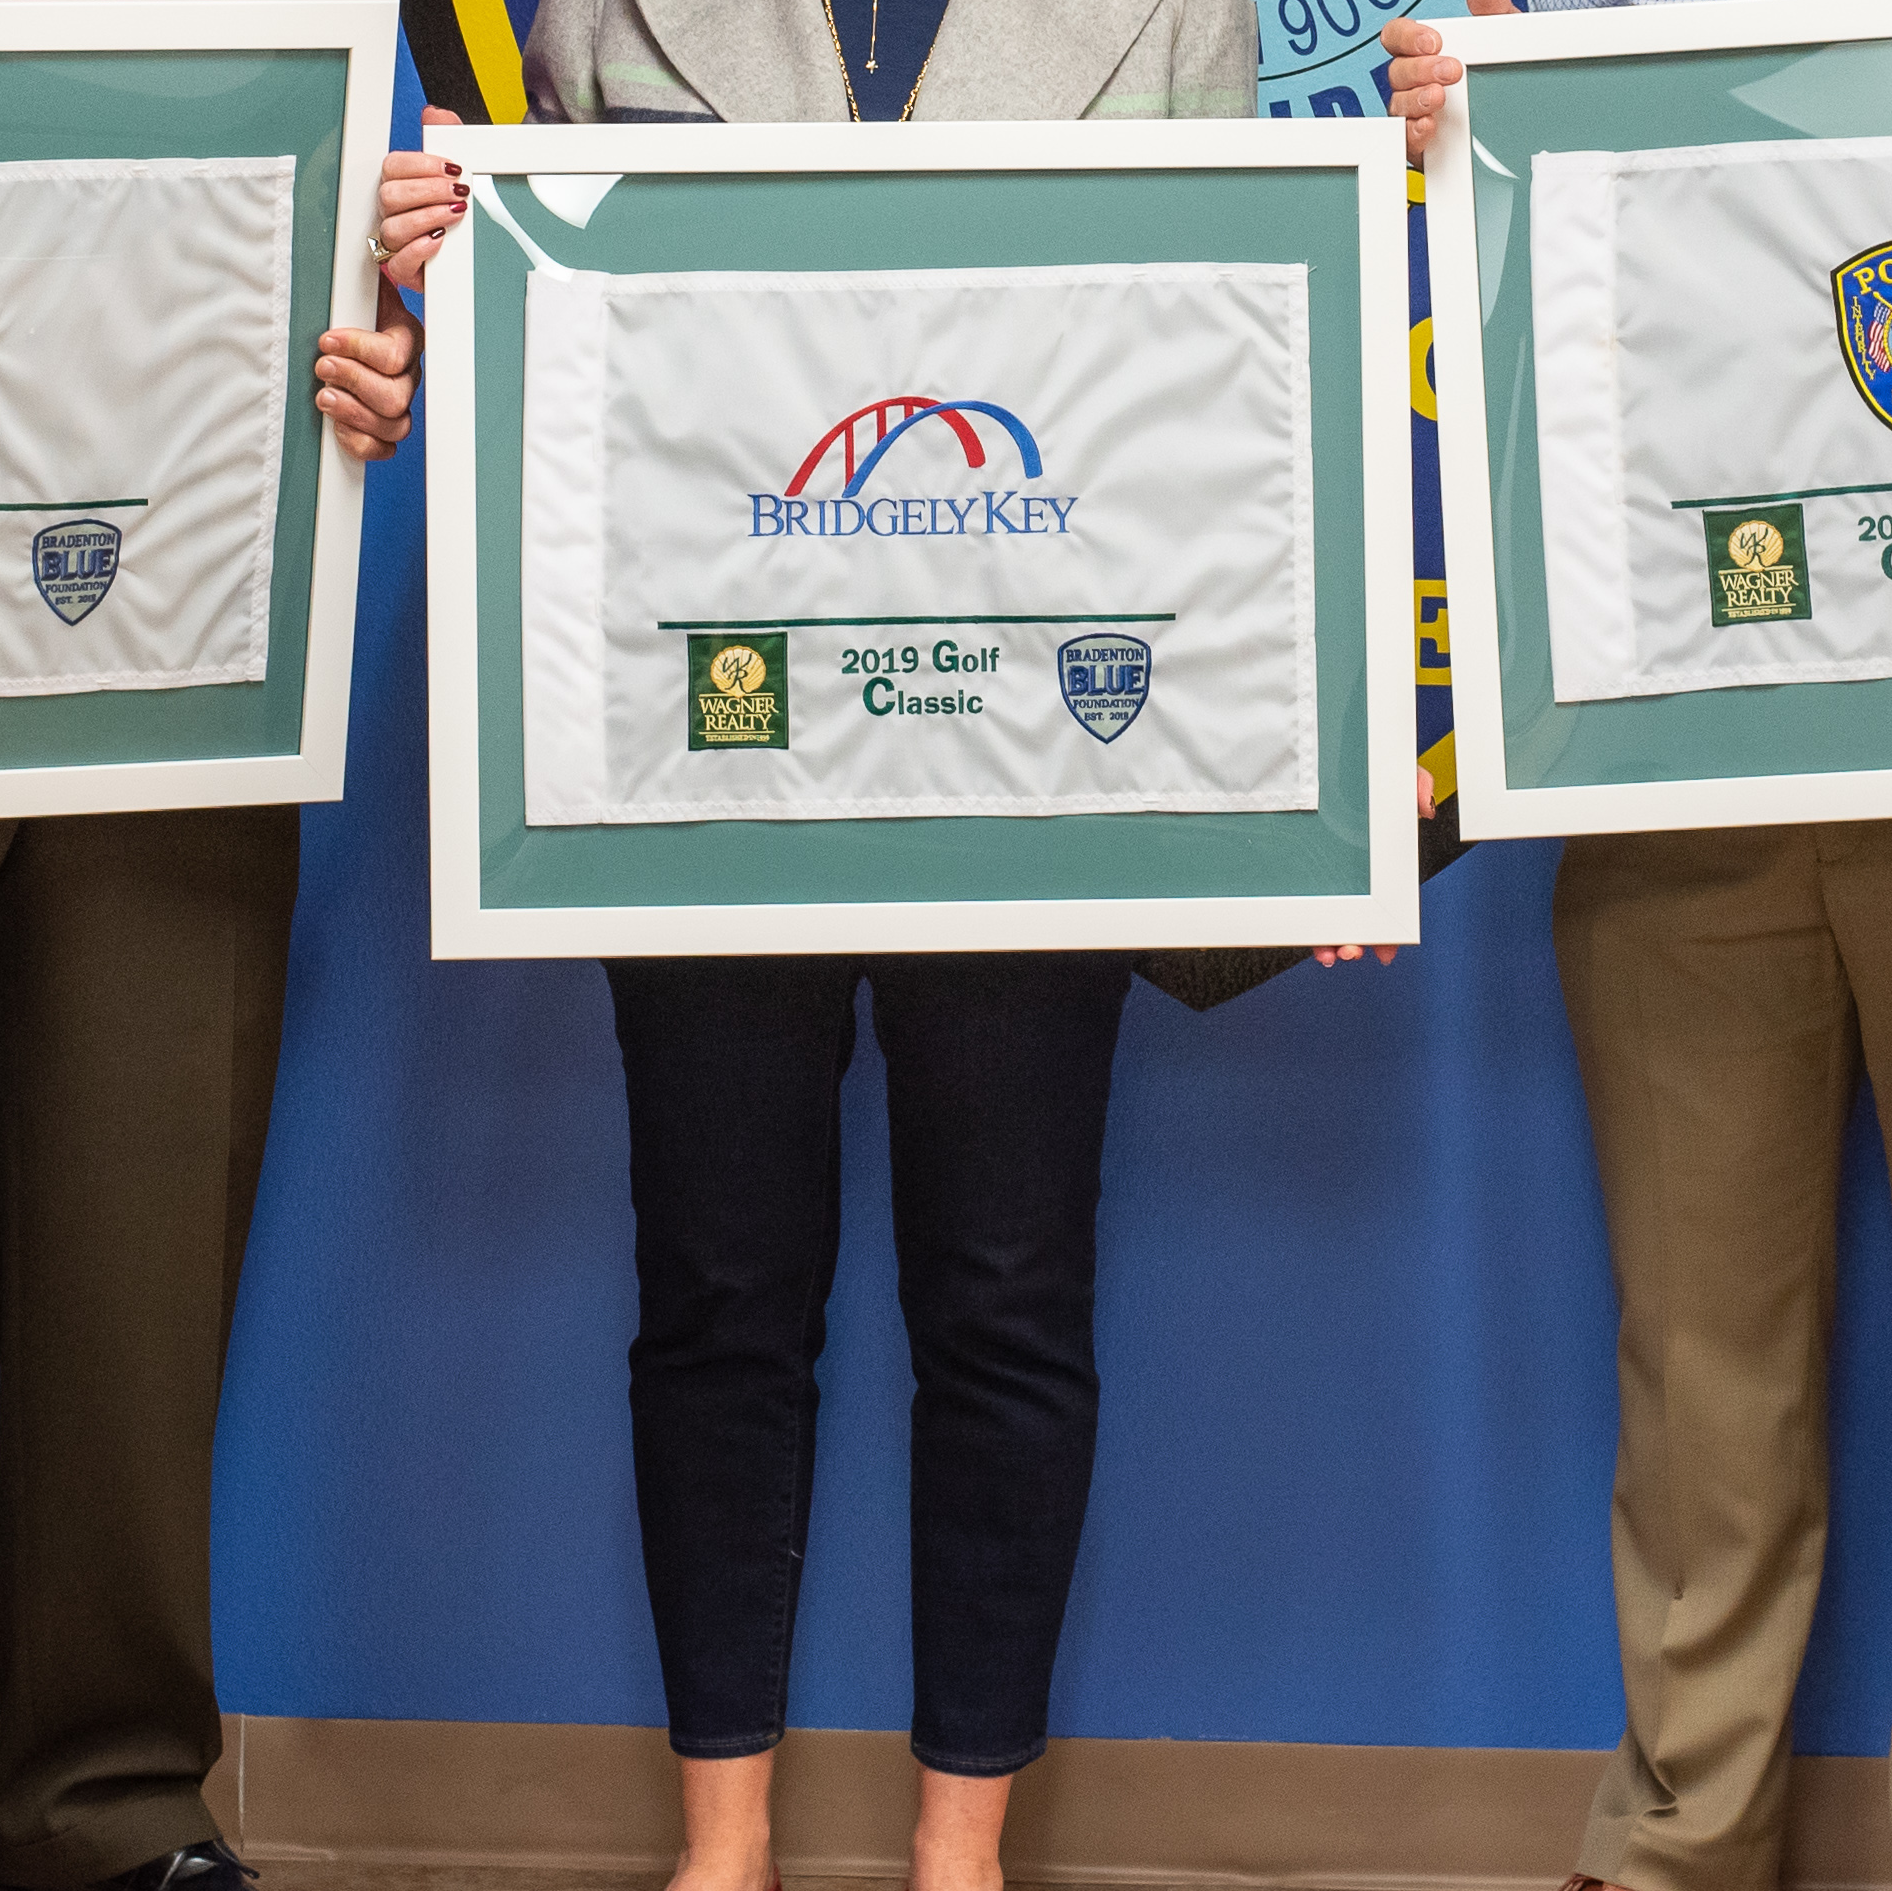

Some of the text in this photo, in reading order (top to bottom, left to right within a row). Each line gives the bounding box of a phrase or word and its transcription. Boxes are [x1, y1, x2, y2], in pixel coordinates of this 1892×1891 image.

[747, 491, 1079, 537] BRIDGELY KEY
[41, 533, 115, 548] BRADENTON
[41, 549, 114, 581] BLUE
[46, 581, 109, 593] FOUNDATION
[1718, 570, 1799, 591] WAGNER
[1725, 586, 1793, 607] REALTY
[841, 639, 1000, 674] 2019 Golf
[1066, 648, 1144, 663] BRADENTON
[1068, 664, 1145, 696] BLUE
[698, 697, 779, 714] WAGNER
[862, 676, 984, 716] Classic
[1073, 699, 1140, 709] FOUNDATION
[704, 713, 772, 731] REALTY
